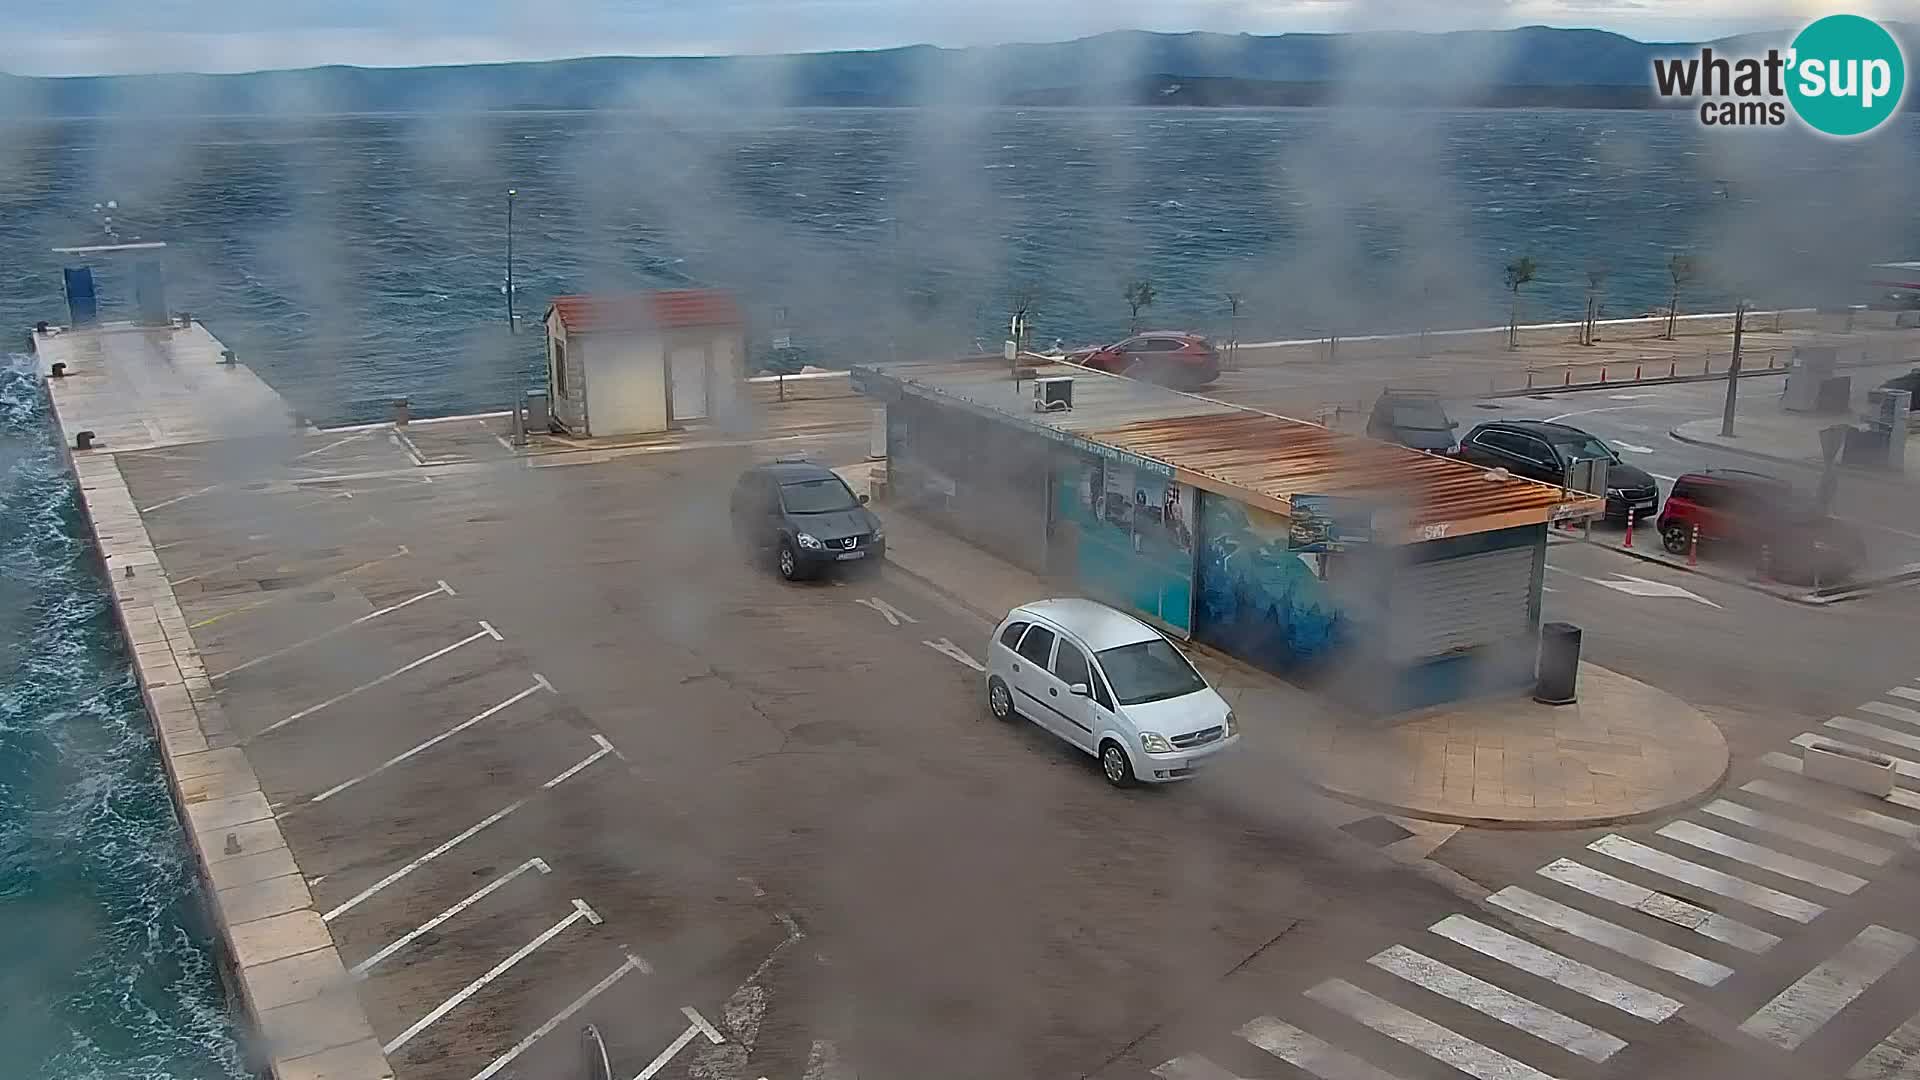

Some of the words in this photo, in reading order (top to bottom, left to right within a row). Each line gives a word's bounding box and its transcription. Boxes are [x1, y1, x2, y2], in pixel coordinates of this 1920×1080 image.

[1088, 443, 1118, 460] STATION
[1120, 453, 1144, 468] TICKET
[1145, 461, 1171, 476] OFFICE
